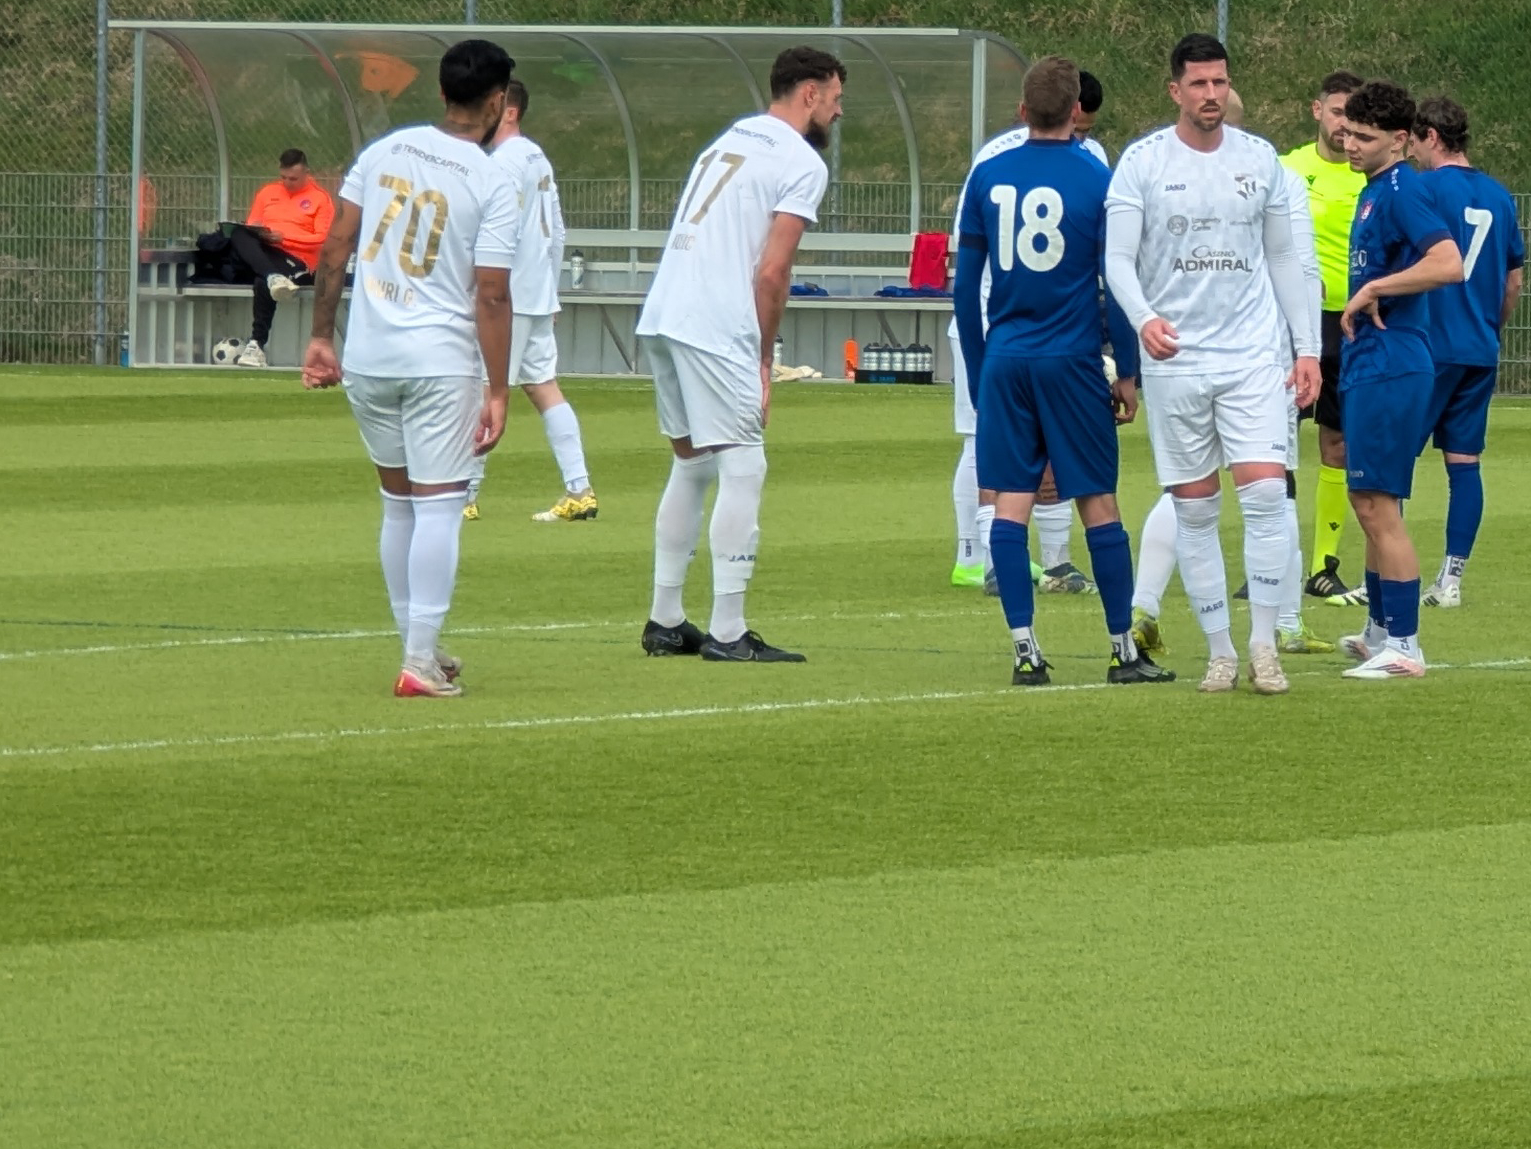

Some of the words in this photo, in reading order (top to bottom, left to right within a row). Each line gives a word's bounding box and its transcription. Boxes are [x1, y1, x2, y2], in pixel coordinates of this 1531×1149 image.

[679, 149, 747, 225] 17
[361, 173, 449, 278] 70
[990, 184, 1065, 272] 18
[1463, 206, 1493, 282] 7
[1172, 257, 1253, 273] ADMIRAL
[728, 554, 757, 562] JAK
[1200, 600, 1224, 614] JAKO
